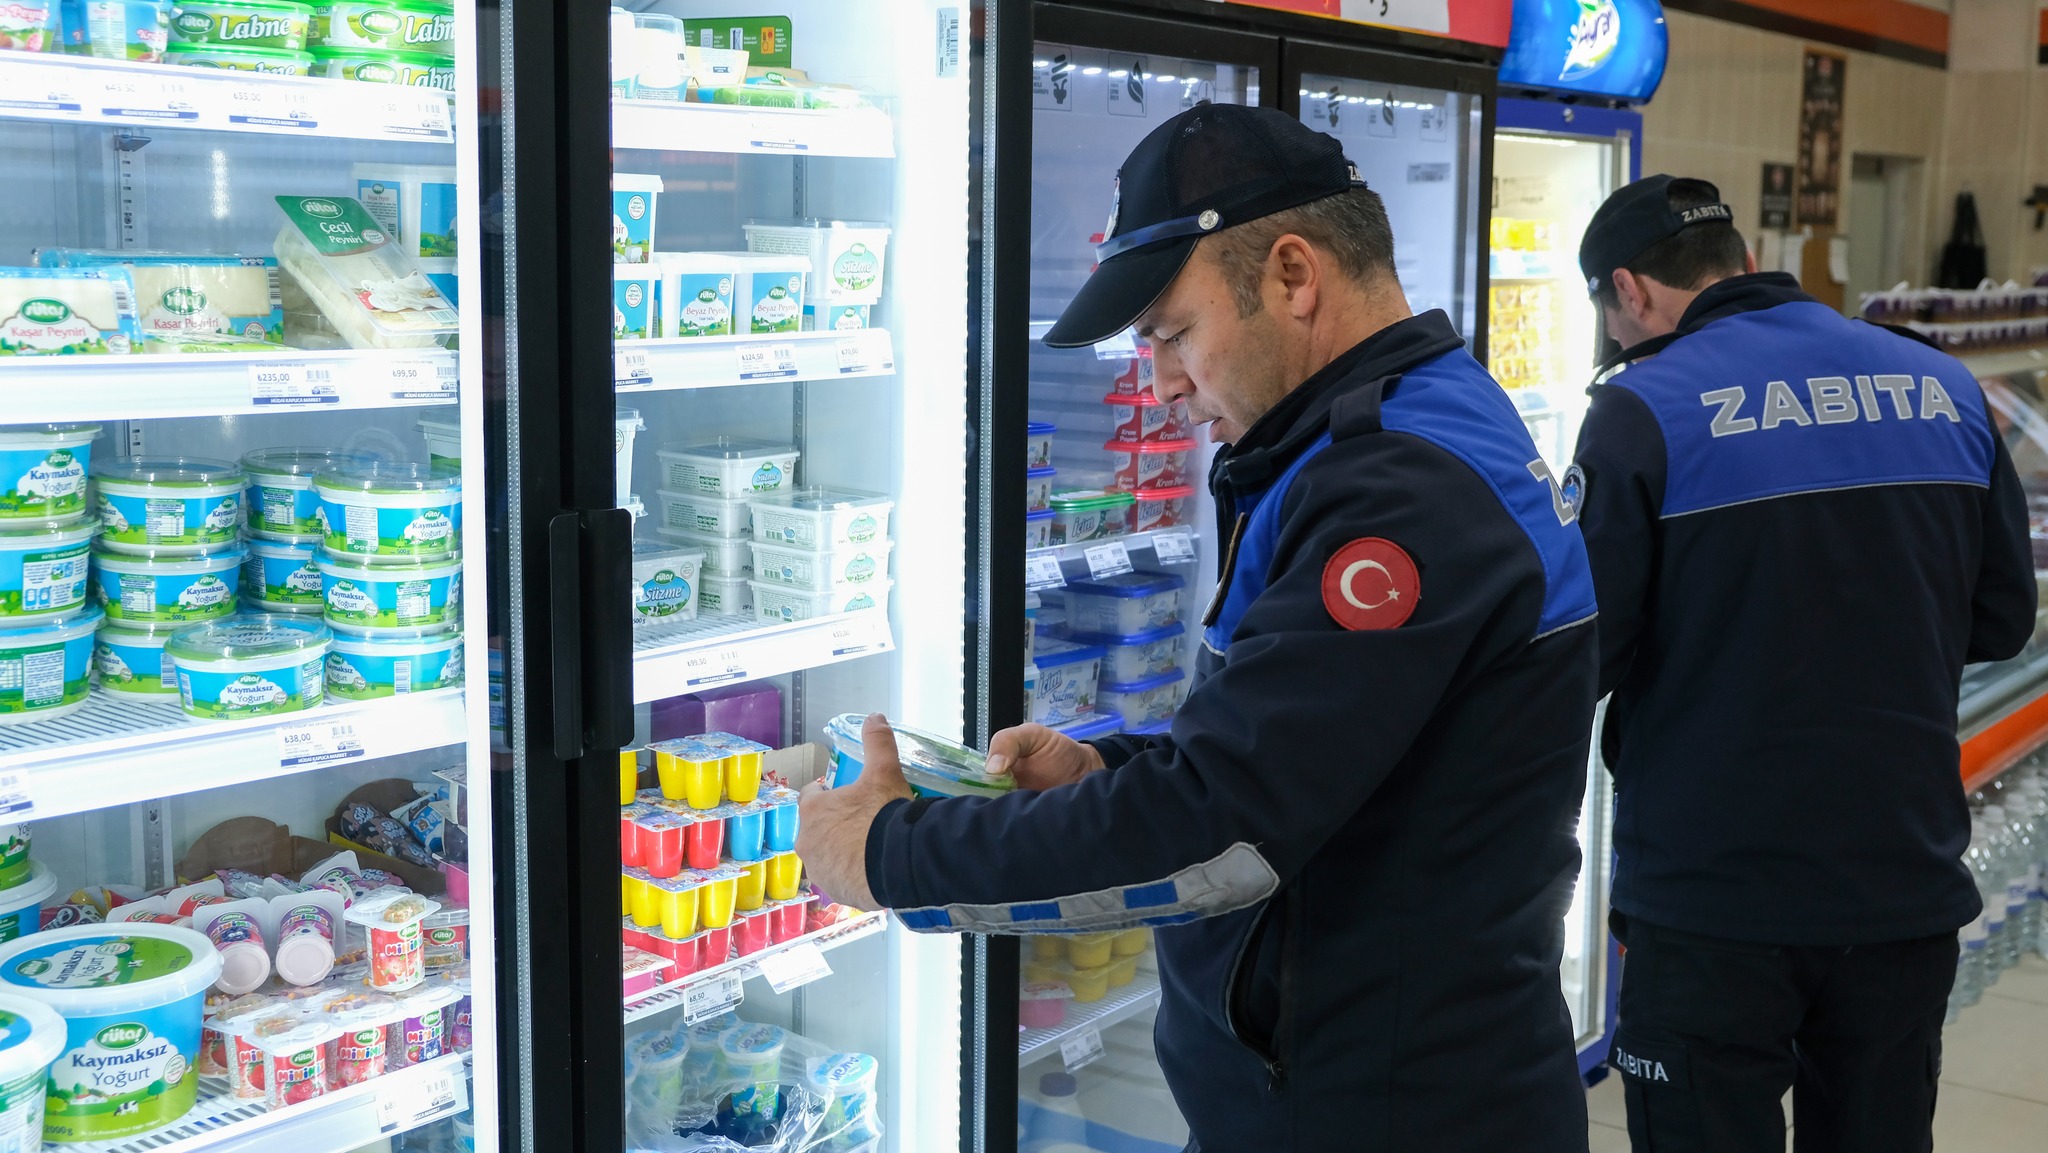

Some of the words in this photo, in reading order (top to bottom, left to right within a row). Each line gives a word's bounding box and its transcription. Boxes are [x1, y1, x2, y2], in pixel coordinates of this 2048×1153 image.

[220, 13, 292, 41] Labne
[404, 14, 455, 44] Labn
[1578, 10, 1613, 49] Ayran
[400, 66, 455, 91] Labn
[1681, 205, 1729, 222] ZABITA
[320, 221, 354, 234] Çeçil
[329, 235, 363, 245] Peyniri
[840, 260, 873, 274] Süzme
[686, 307, 706, 316] Beyaz
[708, 307, 727, 315] Peynir
[758, 303, 776, 313] Beyaz
[778, 303, 797, 313] Peynir
[153, 319, 182, 330] Kaşar
[11, 327, 43, 339] Kaşar
[47, 326, 86, 339] Peyniri
[741, 353, 764, 361] ₺124,50
[257, 373, 290, 382] ₺235,00
[392, 370, 417, 378] ₺99,50
[1701, 374, 1961, 438] ZABITA
[1142, 407, 1167, 429] İçim
[1158, 431, 1177, 440] Krem
[1138, 455, 1164, 475] İçim
[30, 468, 80, 482] Kaymaksız
[42, 481, 72, 494] Yoğurt
[1155, 479, 1173, 488] Krem
[1138, 501, 1163, 521] İçim
[412, 520, 448, 530] Kaymaksız
[1071, 517, 1094, 538] İçim
[420, 529, 441, 538] Yoğurt
[293, 571, 320, 581] Kayma
[186, 585, 224, 596] Kaymaksız
[301, 580, 322, 590] Yoğu
[194, 594, 218, 604] Yoğurt
[331, 588, 365, 601] Kaymaksız
[645, 587, 682, 603] Süzme
[336, 598, 358, 609] Yoğurt
[227, 684, 274, 695] Kaymaksız
[1036, 669, 1063, 700] İçim
[236, 693, 265, 704] Yoğurt
[1049, 690, 1076, 703] Süzme
[284, 733, 311, 743] ₺38,00
[330, 752, 348, 760] MARKET
[18, 822, 32, 836] Yoğ
[47, 949, 87, 985] Kaymaksız
[75, 957, 105, 979] Yoğurt
[72, 1044, 168, 1071] Kaymaksız
[1616, 1046, 1670, 1082] ZABITA
[92, 1066, 150, 1088] Yoğurt
[44, 1125, 67, 1135] 2000
